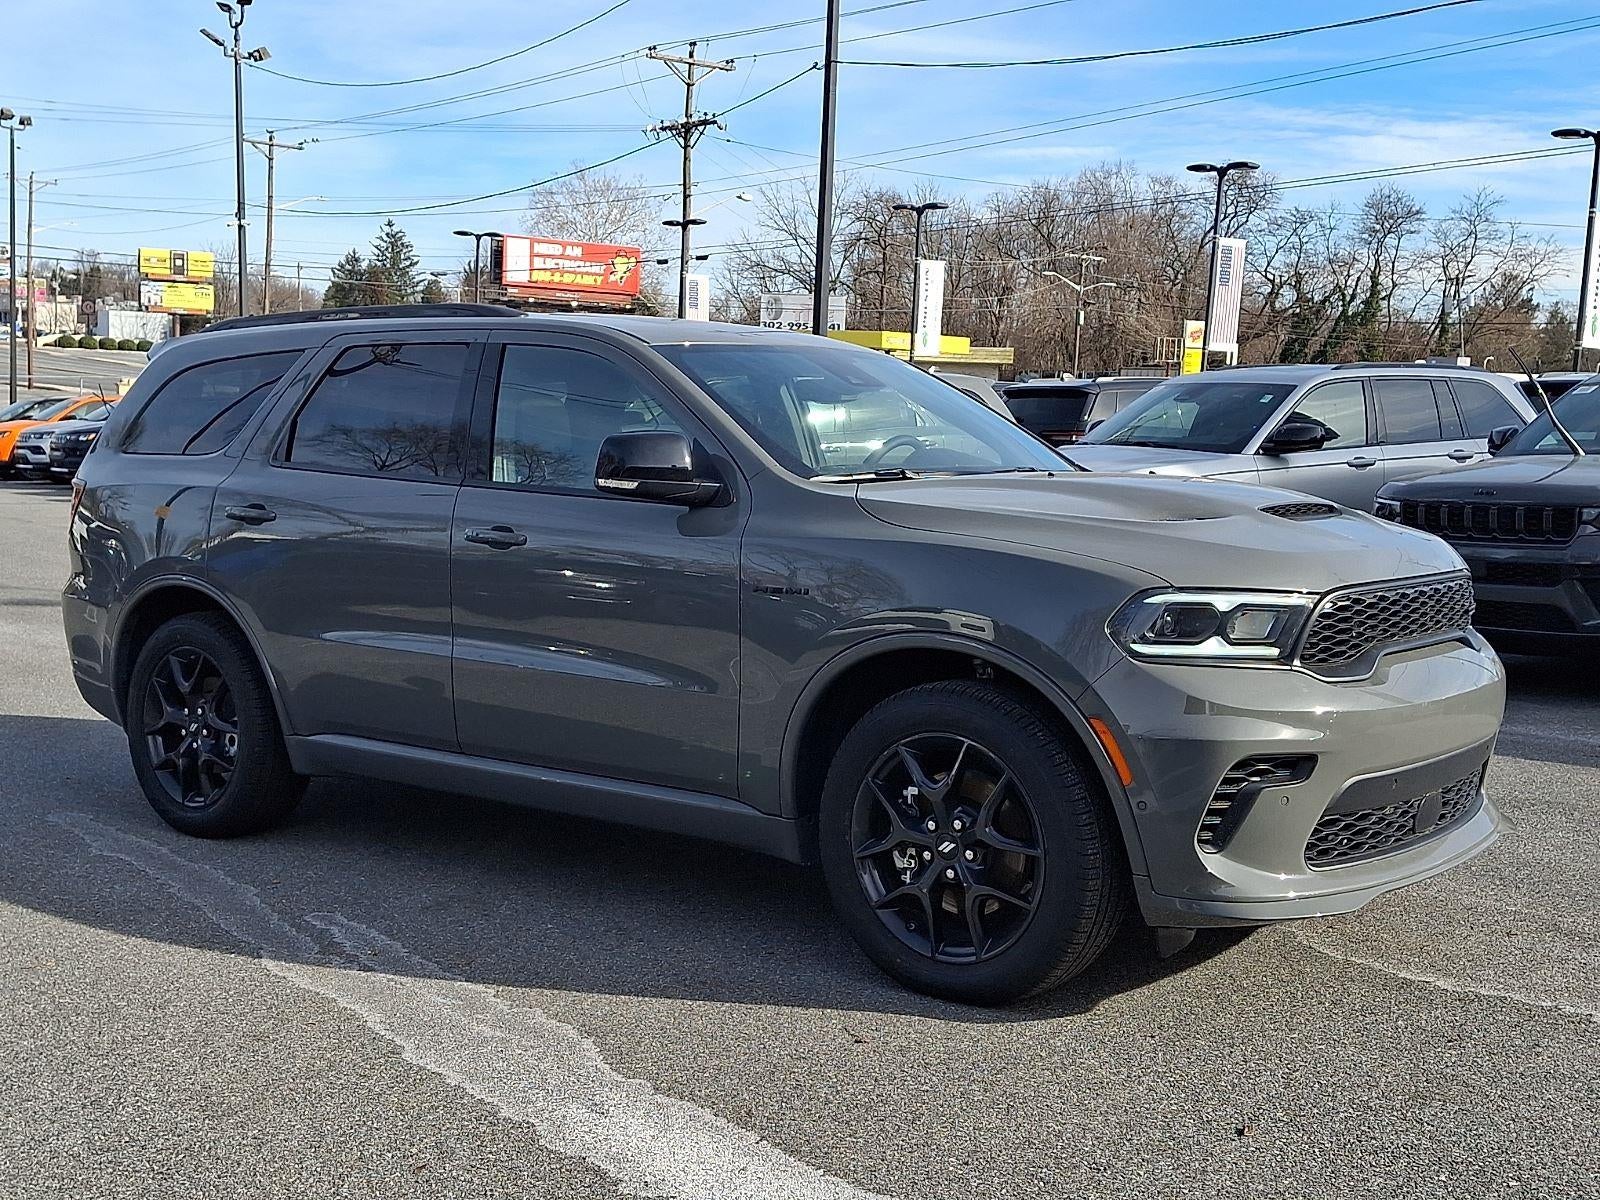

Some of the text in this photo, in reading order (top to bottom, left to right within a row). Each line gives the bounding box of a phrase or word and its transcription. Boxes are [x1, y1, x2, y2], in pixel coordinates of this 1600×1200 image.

[533, 242, 583, 257] NEED AN
[761, 321, 841, 331] 302-995-41
